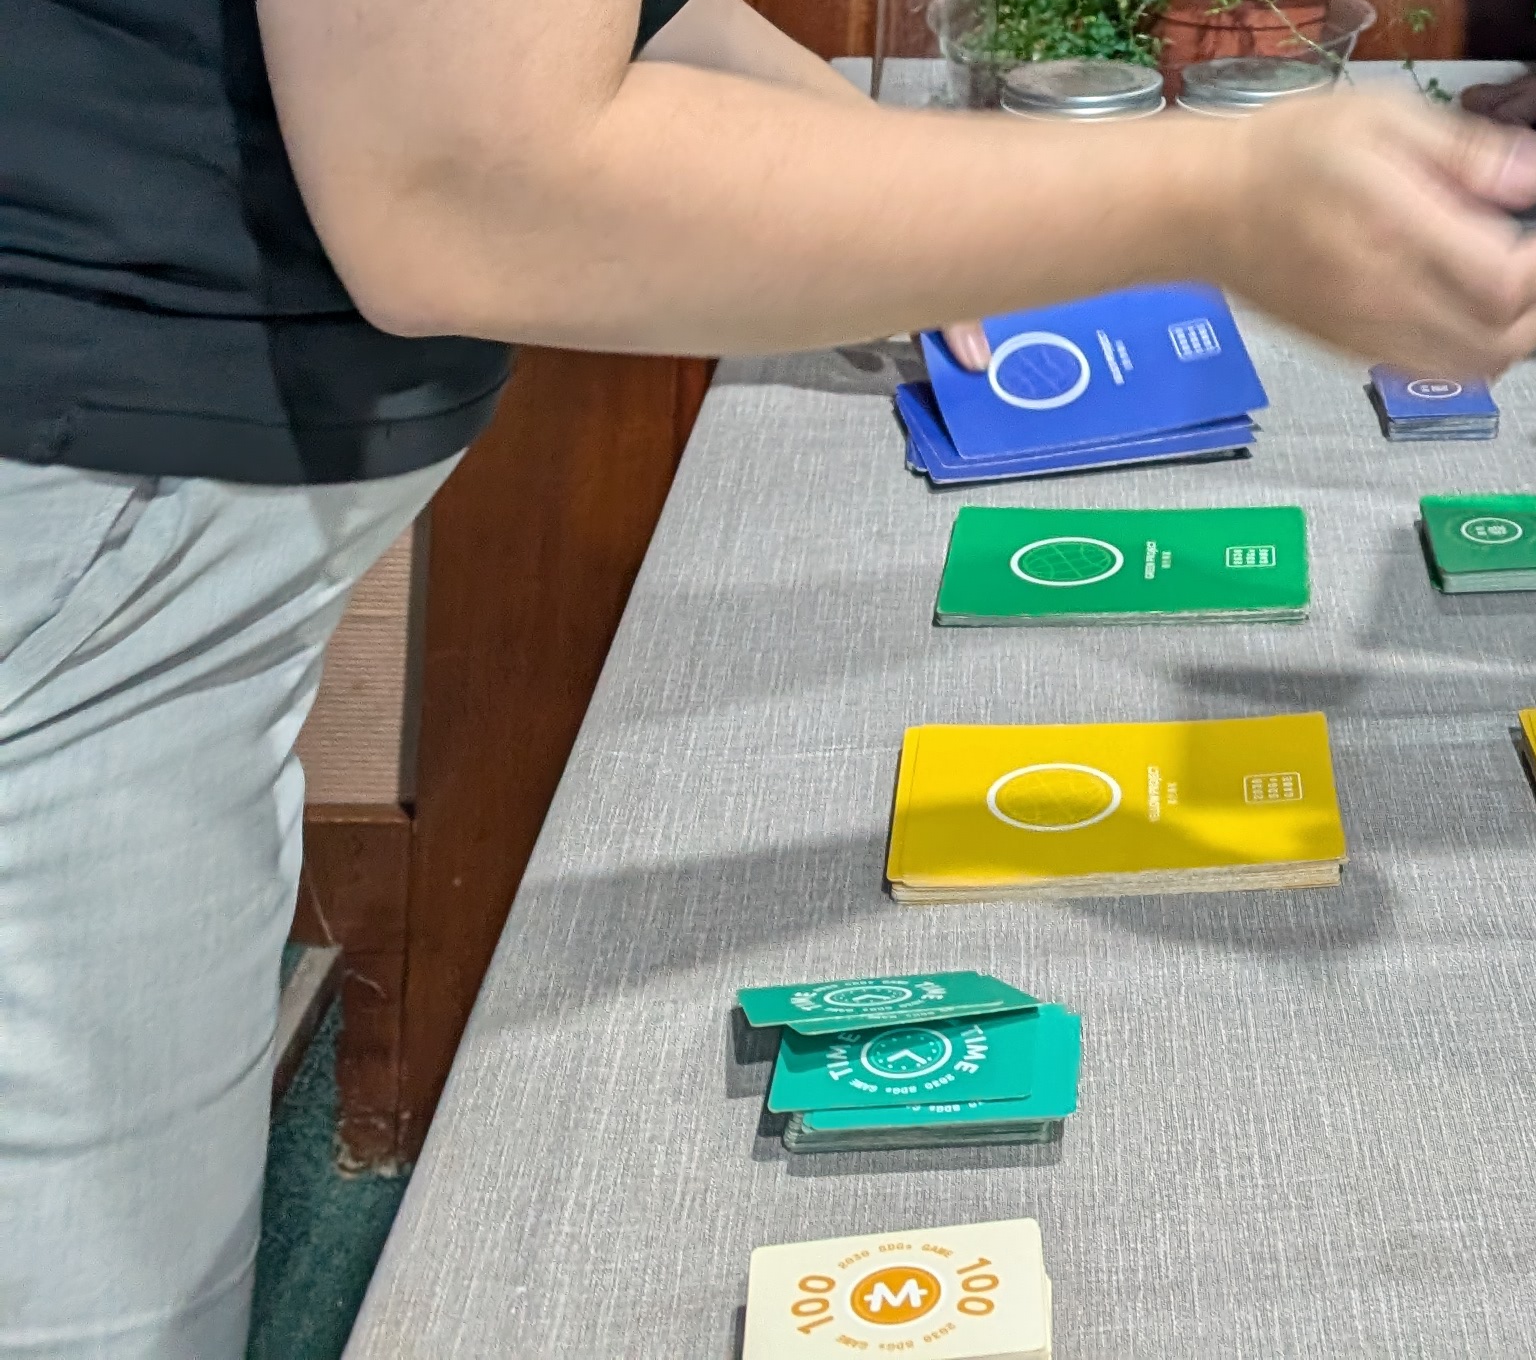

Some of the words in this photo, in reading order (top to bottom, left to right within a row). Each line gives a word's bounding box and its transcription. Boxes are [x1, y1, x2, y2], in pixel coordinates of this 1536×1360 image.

[826, 1032, 861, 1081] TIME
[954, 1024, 989, 1074] TIME
[791, 1275, 836, 1335] 100
[955, 1257, 999, 1316] 100
